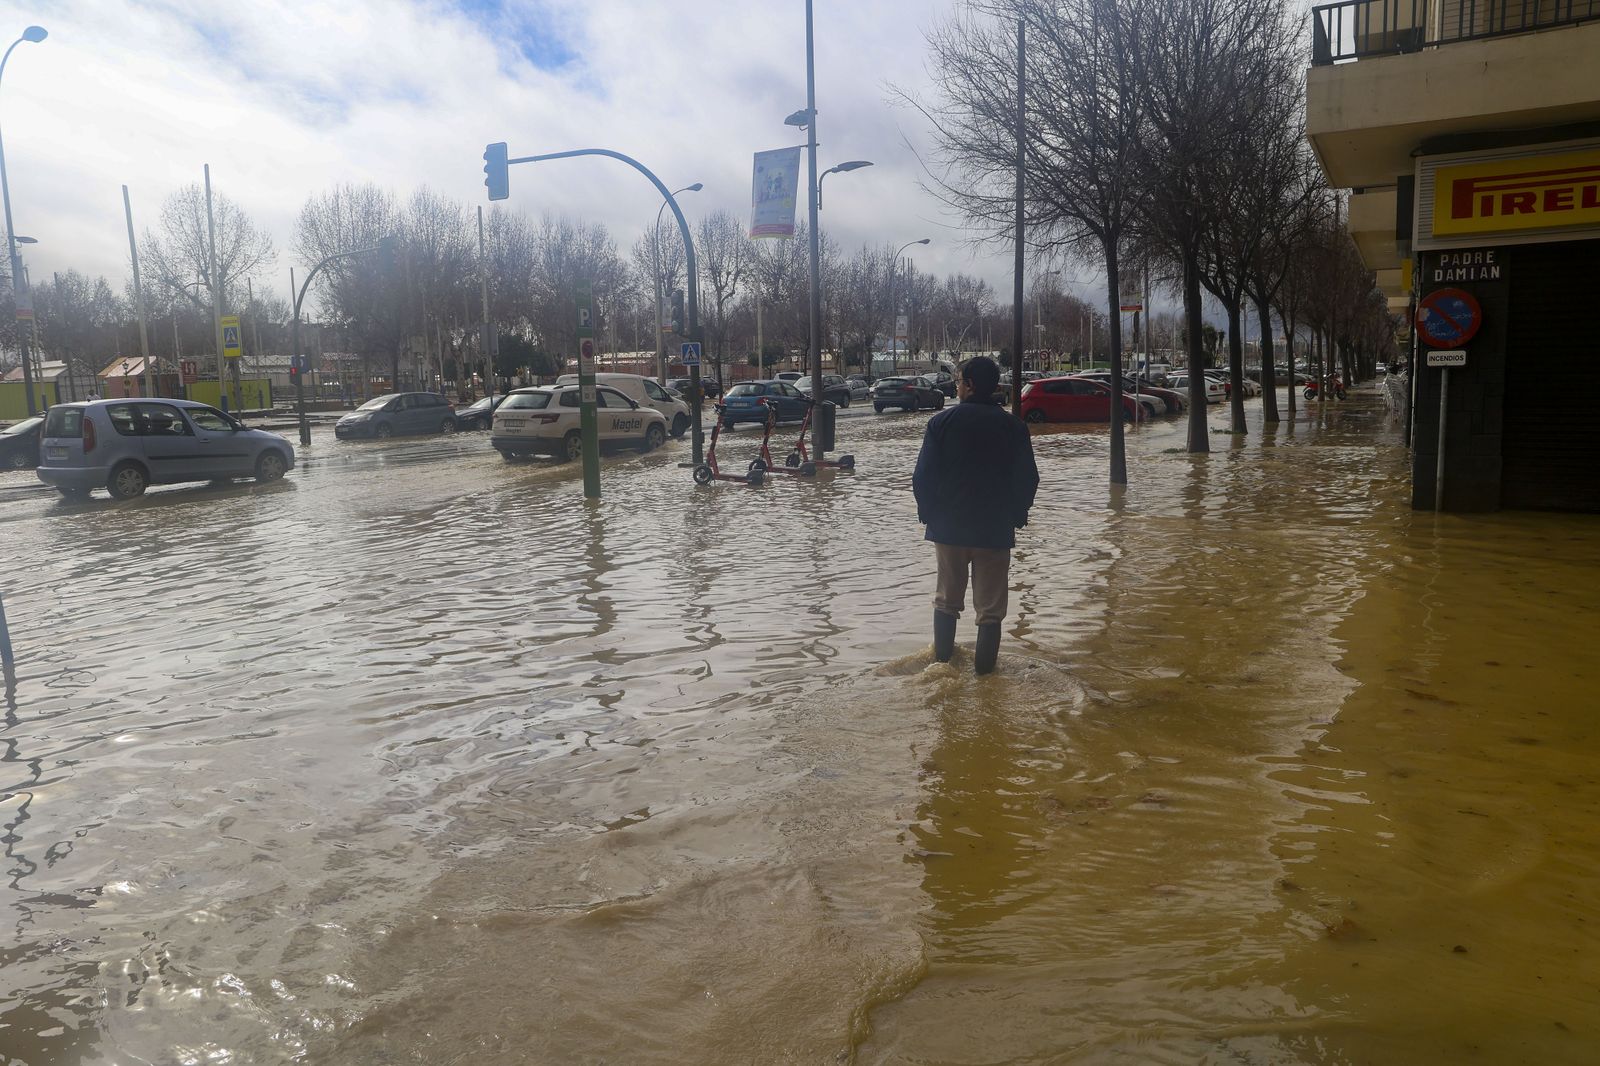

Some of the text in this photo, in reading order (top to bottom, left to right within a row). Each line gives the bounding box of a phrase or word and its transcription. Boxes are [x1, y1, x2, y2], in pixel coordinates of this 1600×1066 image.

[1440, 251, 1495, 267] PADRE
[1434, 266, 1500, 281] DAMIAN
[1429, 354, 1465, 362] INCENDIOS
[612, 416, 643, 432] Magtel
